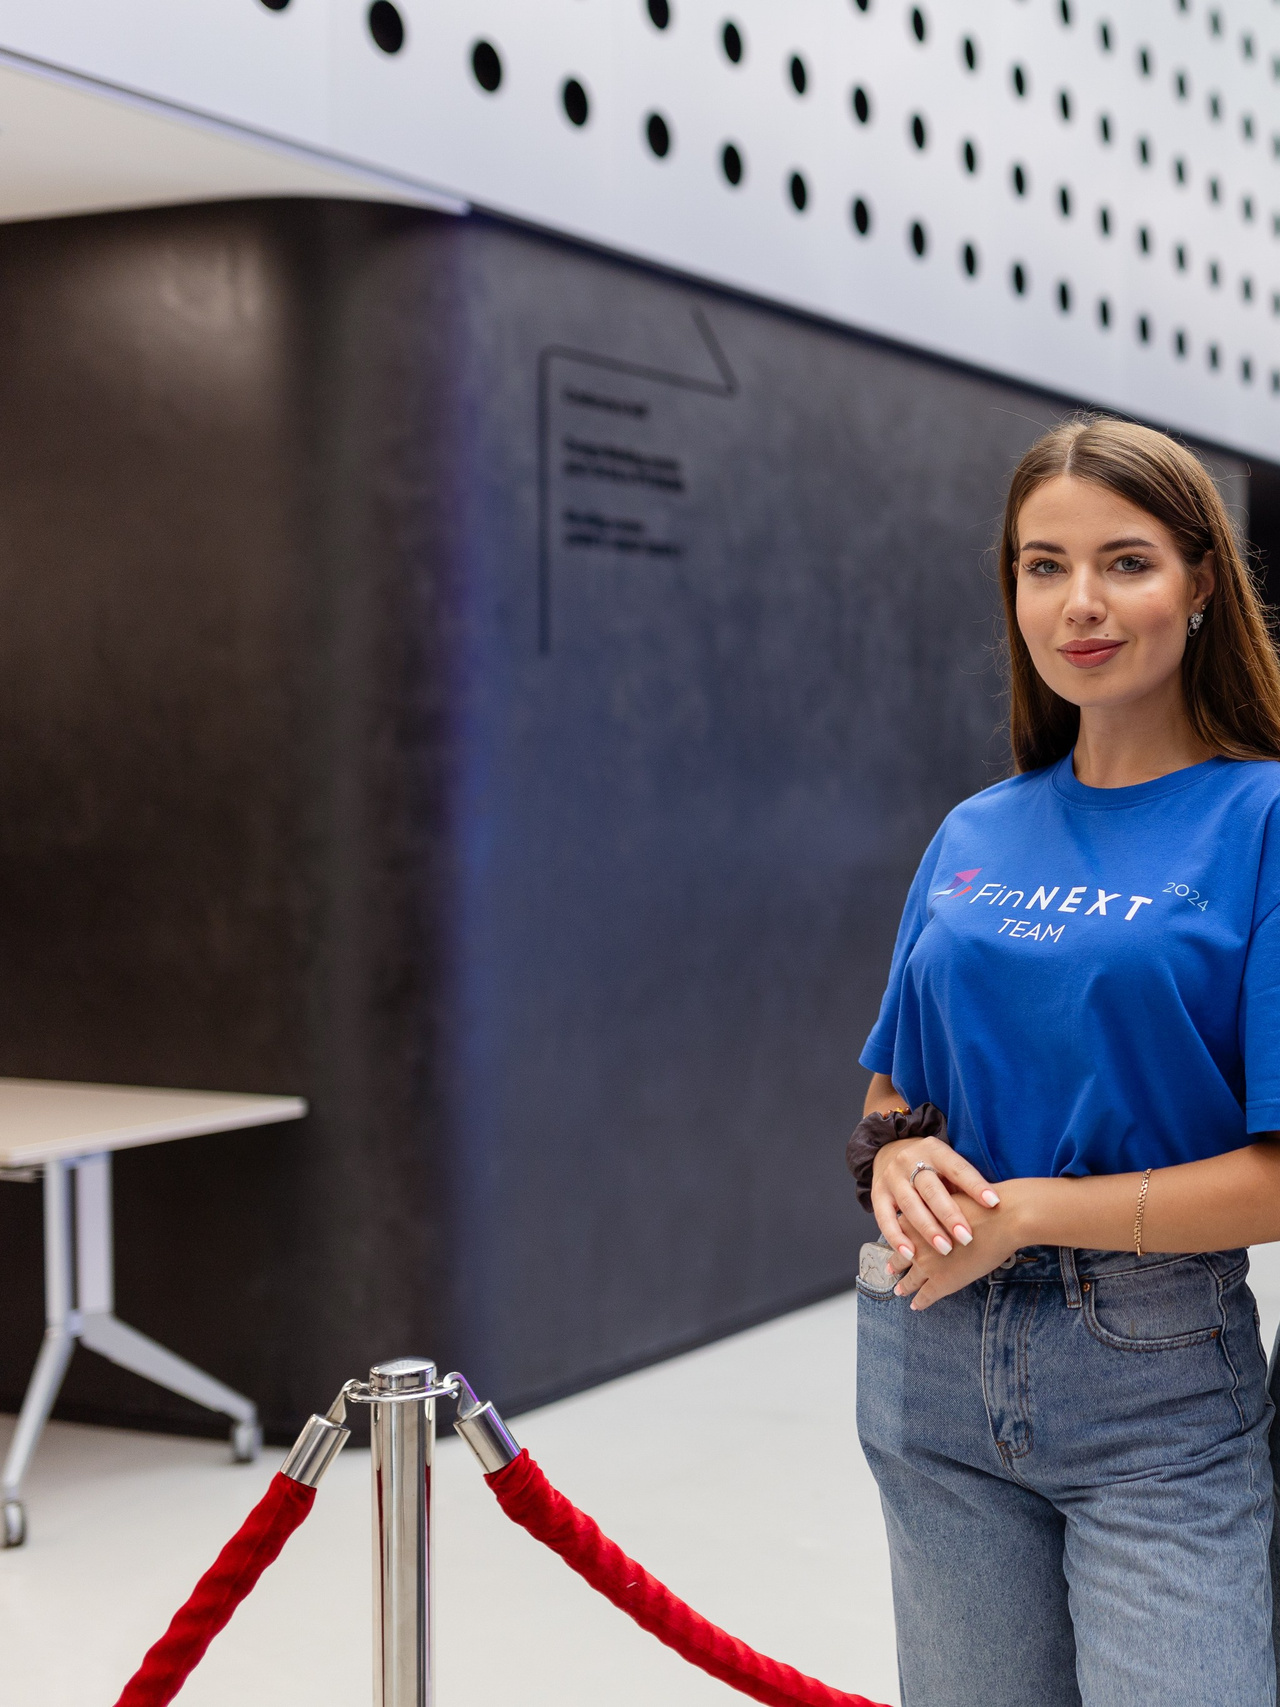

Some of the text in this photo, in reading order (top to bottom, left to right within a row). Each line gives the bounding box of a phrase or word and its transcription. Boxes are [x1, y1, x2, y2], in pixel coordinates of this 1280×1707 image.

[969, 881, 1210, 921] FinNEXT 2024
[997, 918, 1066, 943] TEAM
